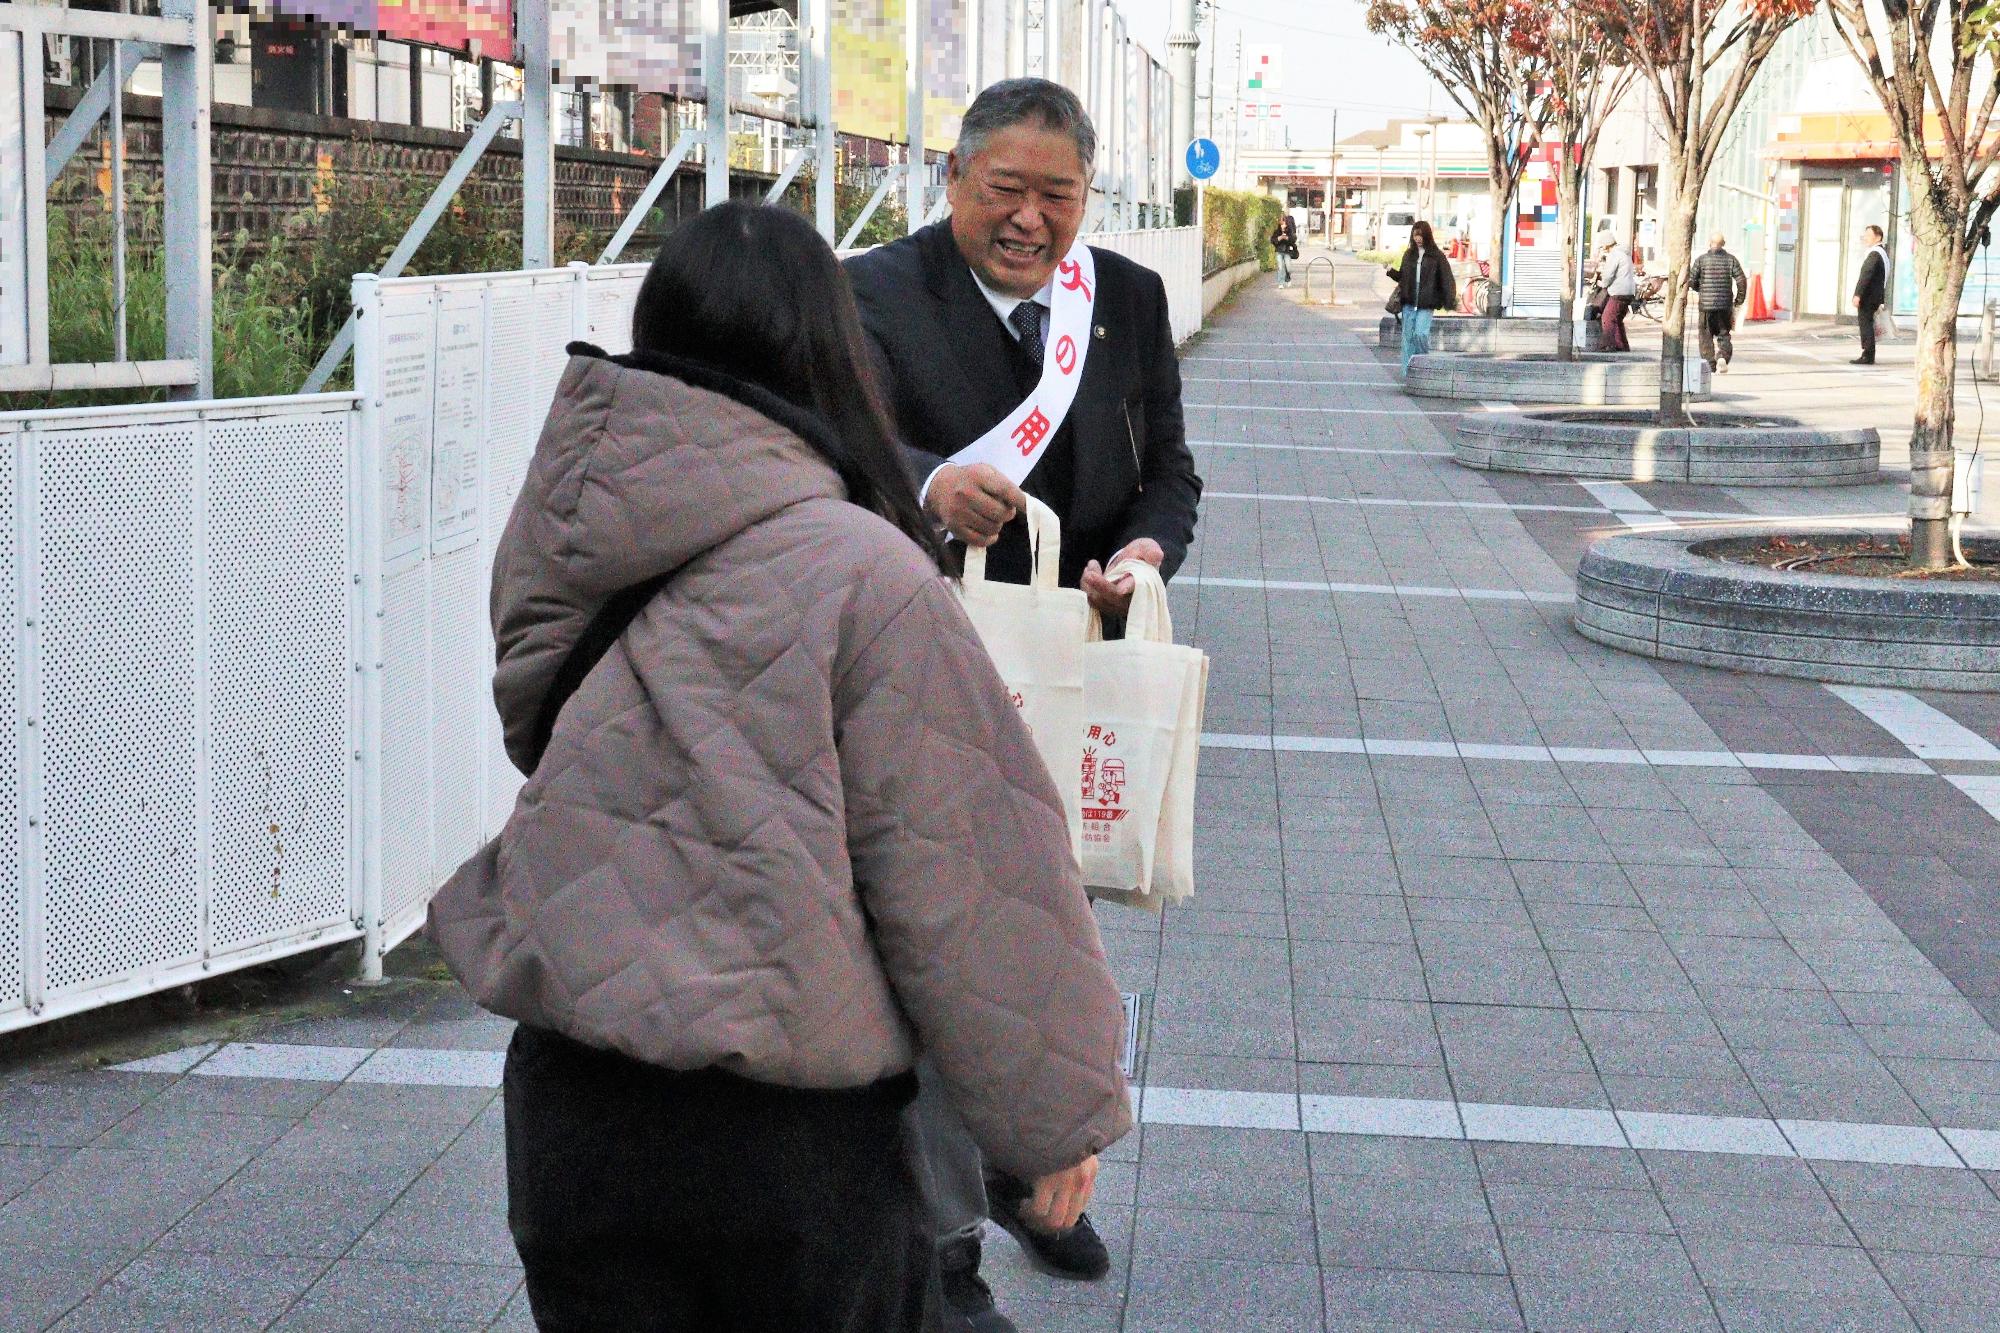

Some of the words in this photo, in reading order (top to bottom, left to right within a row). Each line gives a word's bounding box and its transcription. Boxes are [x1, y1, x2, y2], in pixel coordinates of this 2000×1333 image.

[1082, 725, 1116, 747] 用心
[1082, 832, 1111, 842] 防協会
